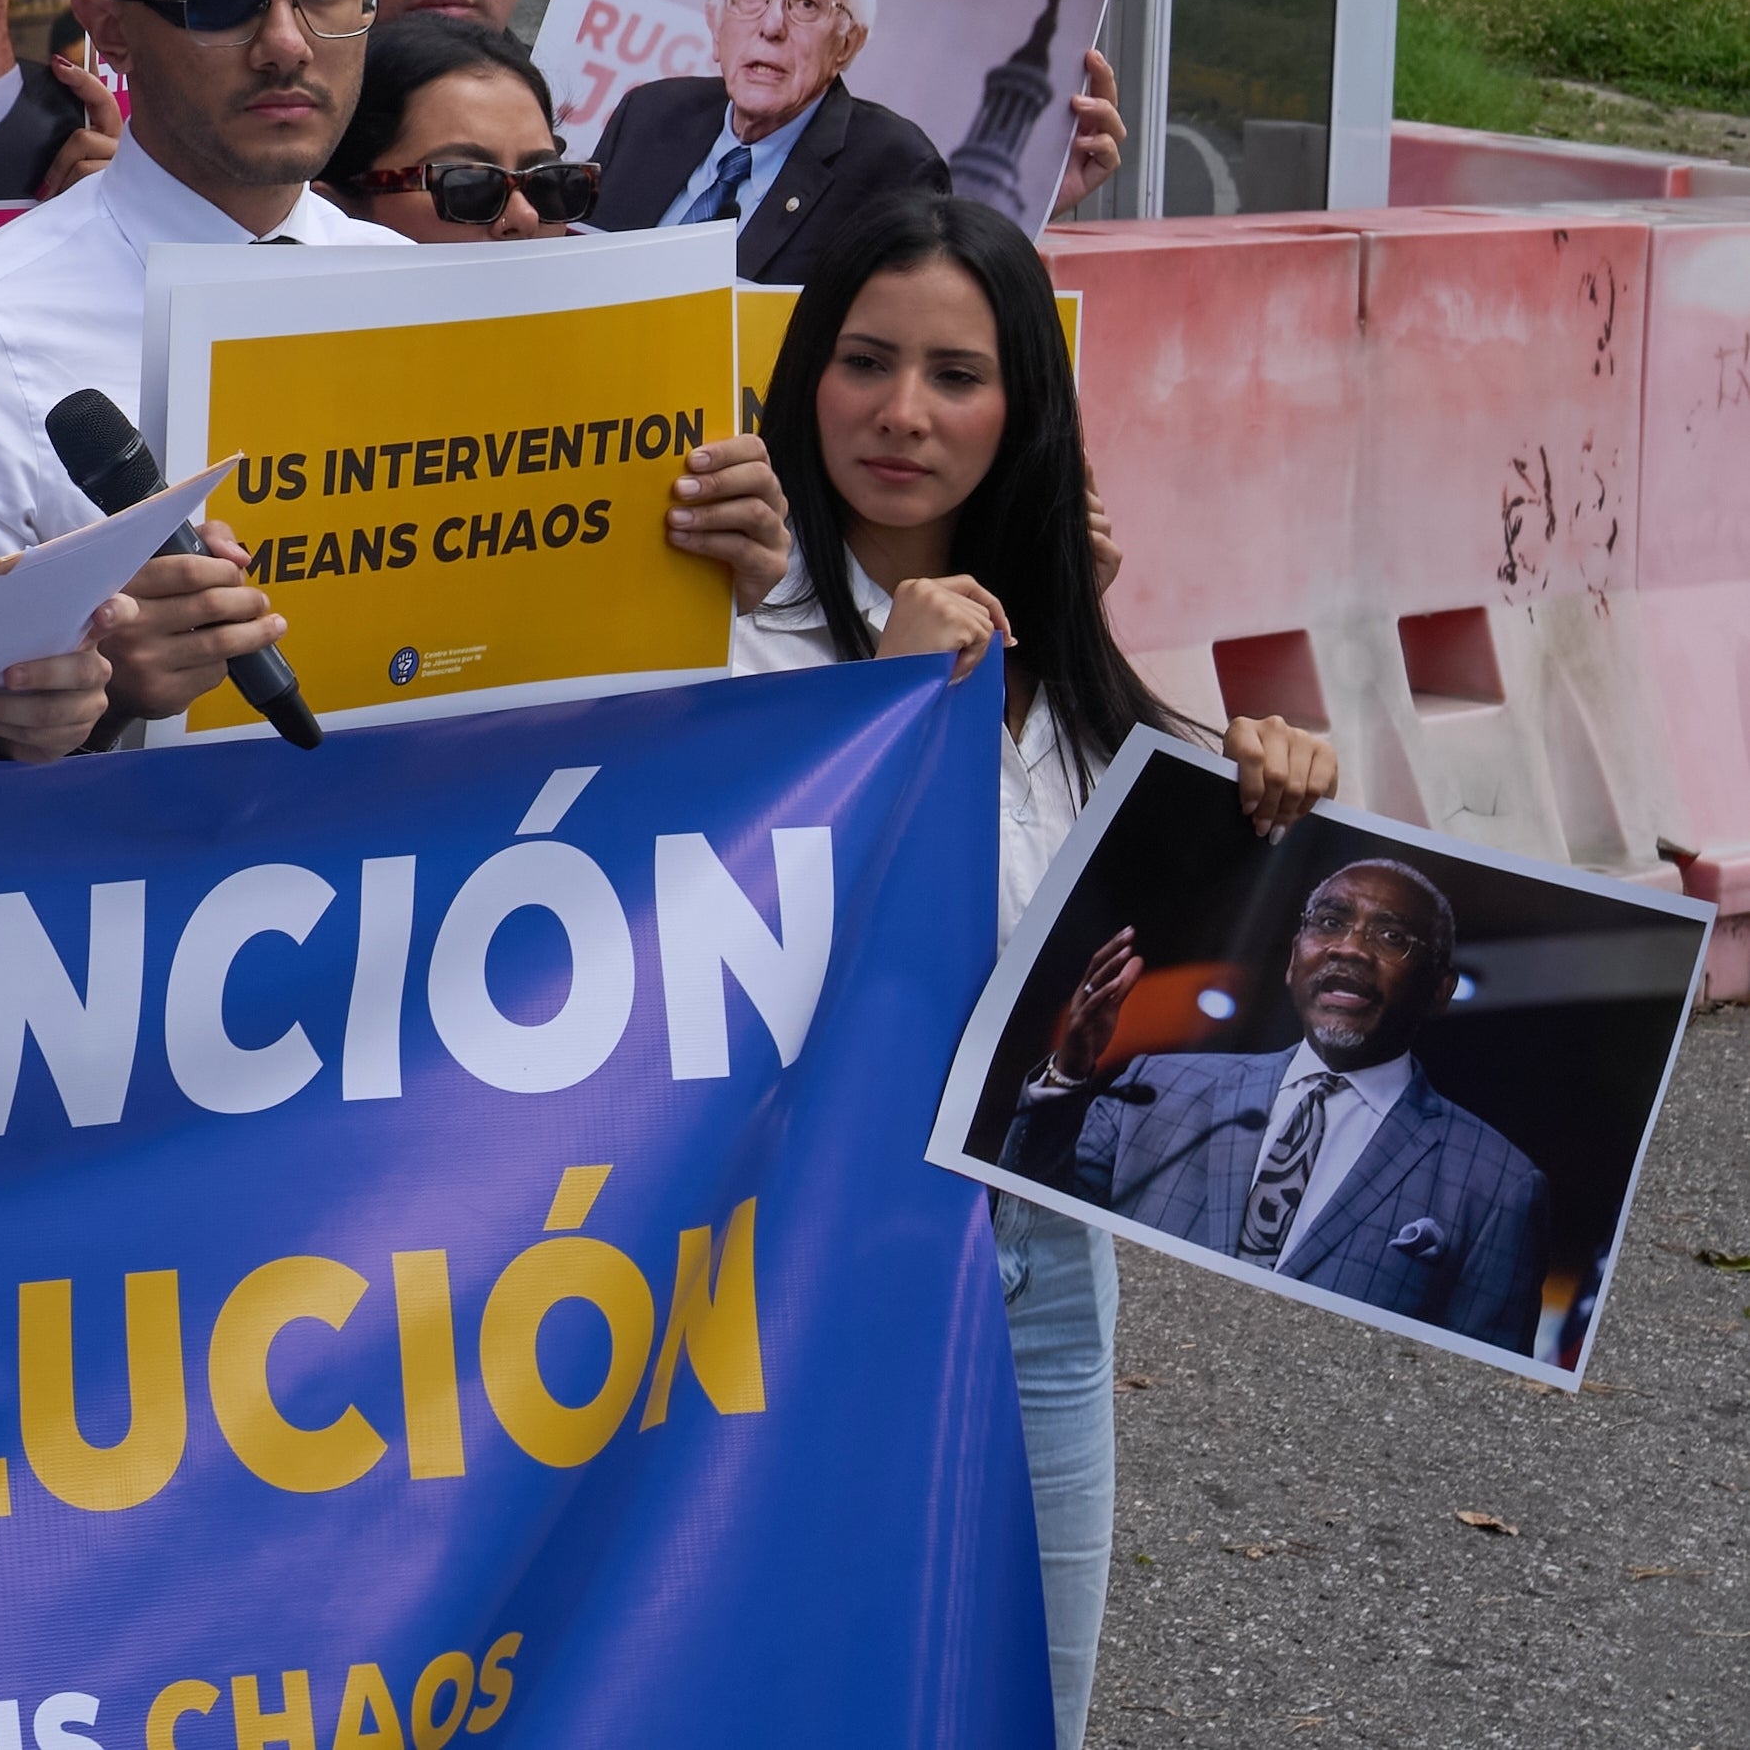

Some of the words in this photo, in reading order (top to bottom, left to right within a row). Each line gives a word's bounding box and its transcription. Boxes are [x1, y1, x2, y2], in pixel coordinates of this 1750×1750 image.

[237, 453, 308, 505] US
[322, 408, 704, 496] INTERVENTION
[239, 523, 418, 585] MEANS
[431, 499, 612, 564] CHAOS
[145, 1631, 524, 1750] CHAOS
